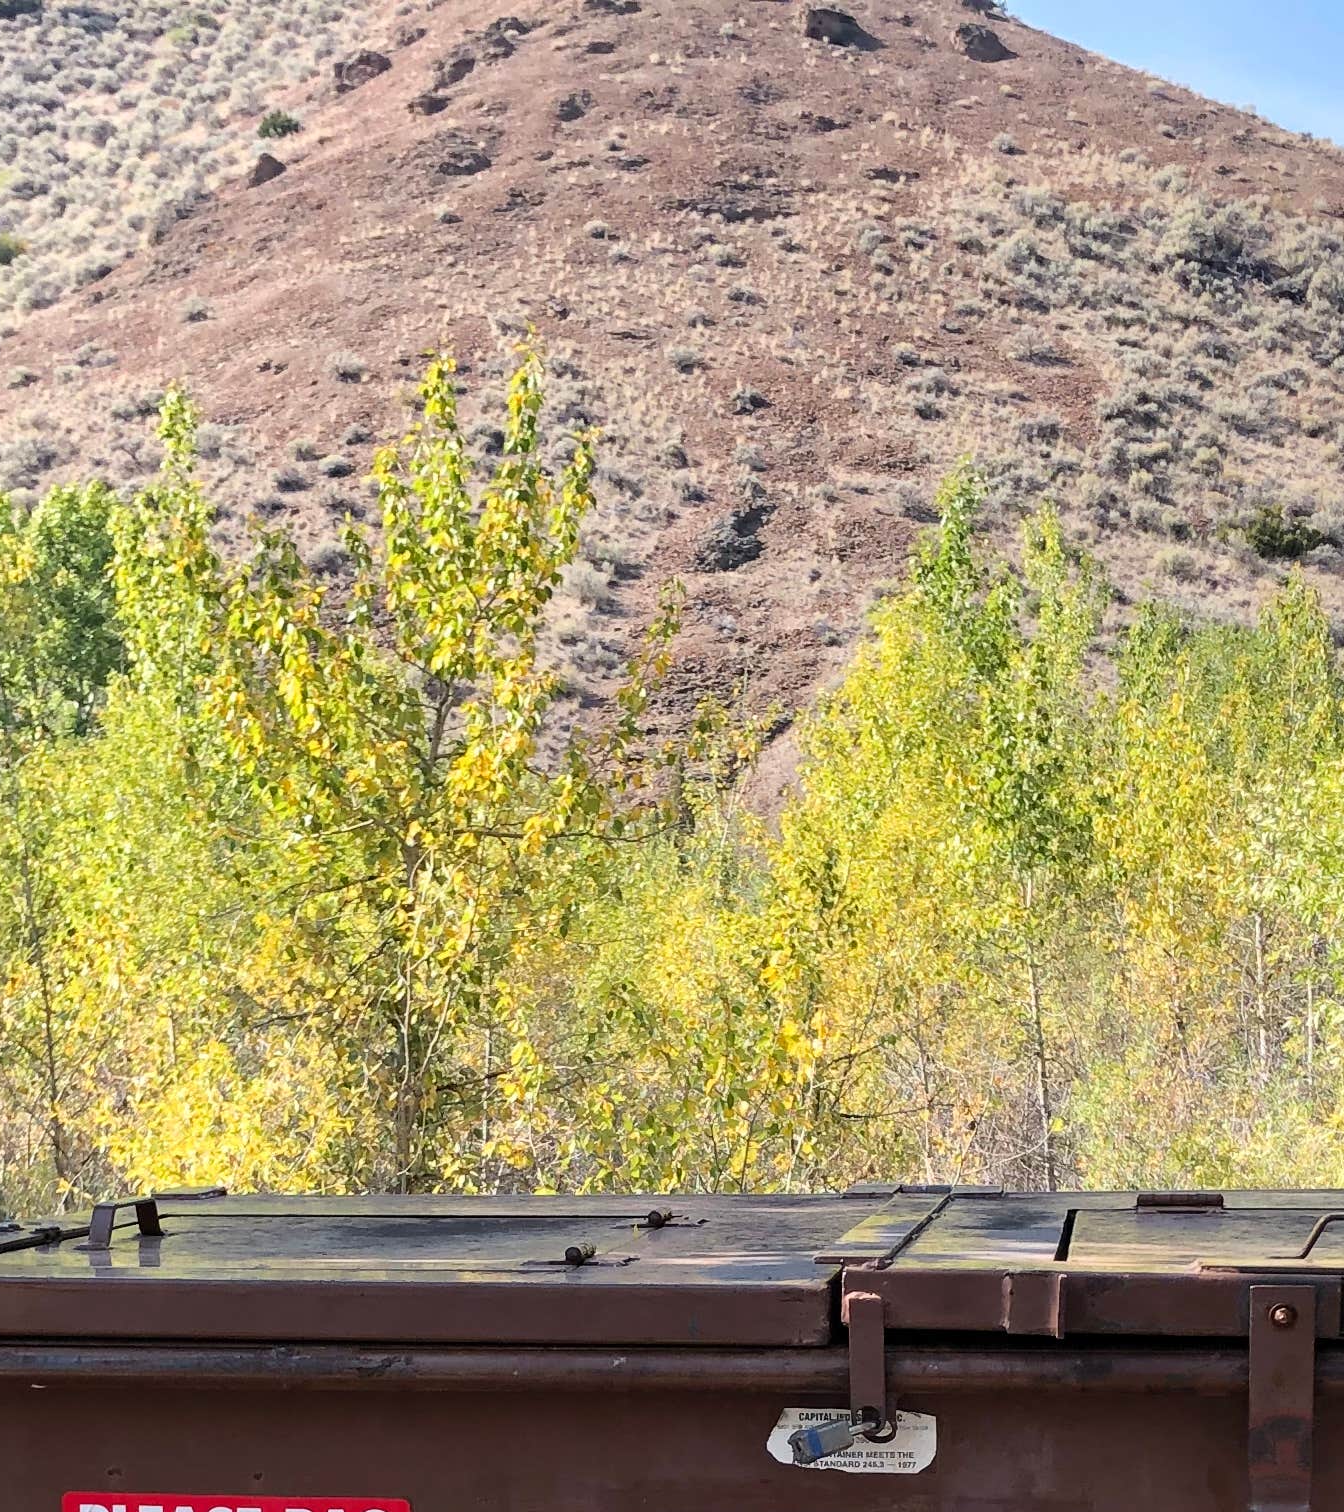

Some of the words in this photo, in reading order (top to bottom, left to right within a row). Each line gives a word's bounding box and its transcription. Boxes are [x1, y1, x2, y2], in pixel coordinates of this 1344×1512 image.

[798, 1412, 833, 1421] CAPITAL
[830, 1451, 864, 1459] TAINER
[866, 1451, 895, 1459] MEETS
[898, 1451, 915, 1459] THE
[813, 1460, 861, 1468] STANDARD
[897, 1461, 917, 1469] 1977
